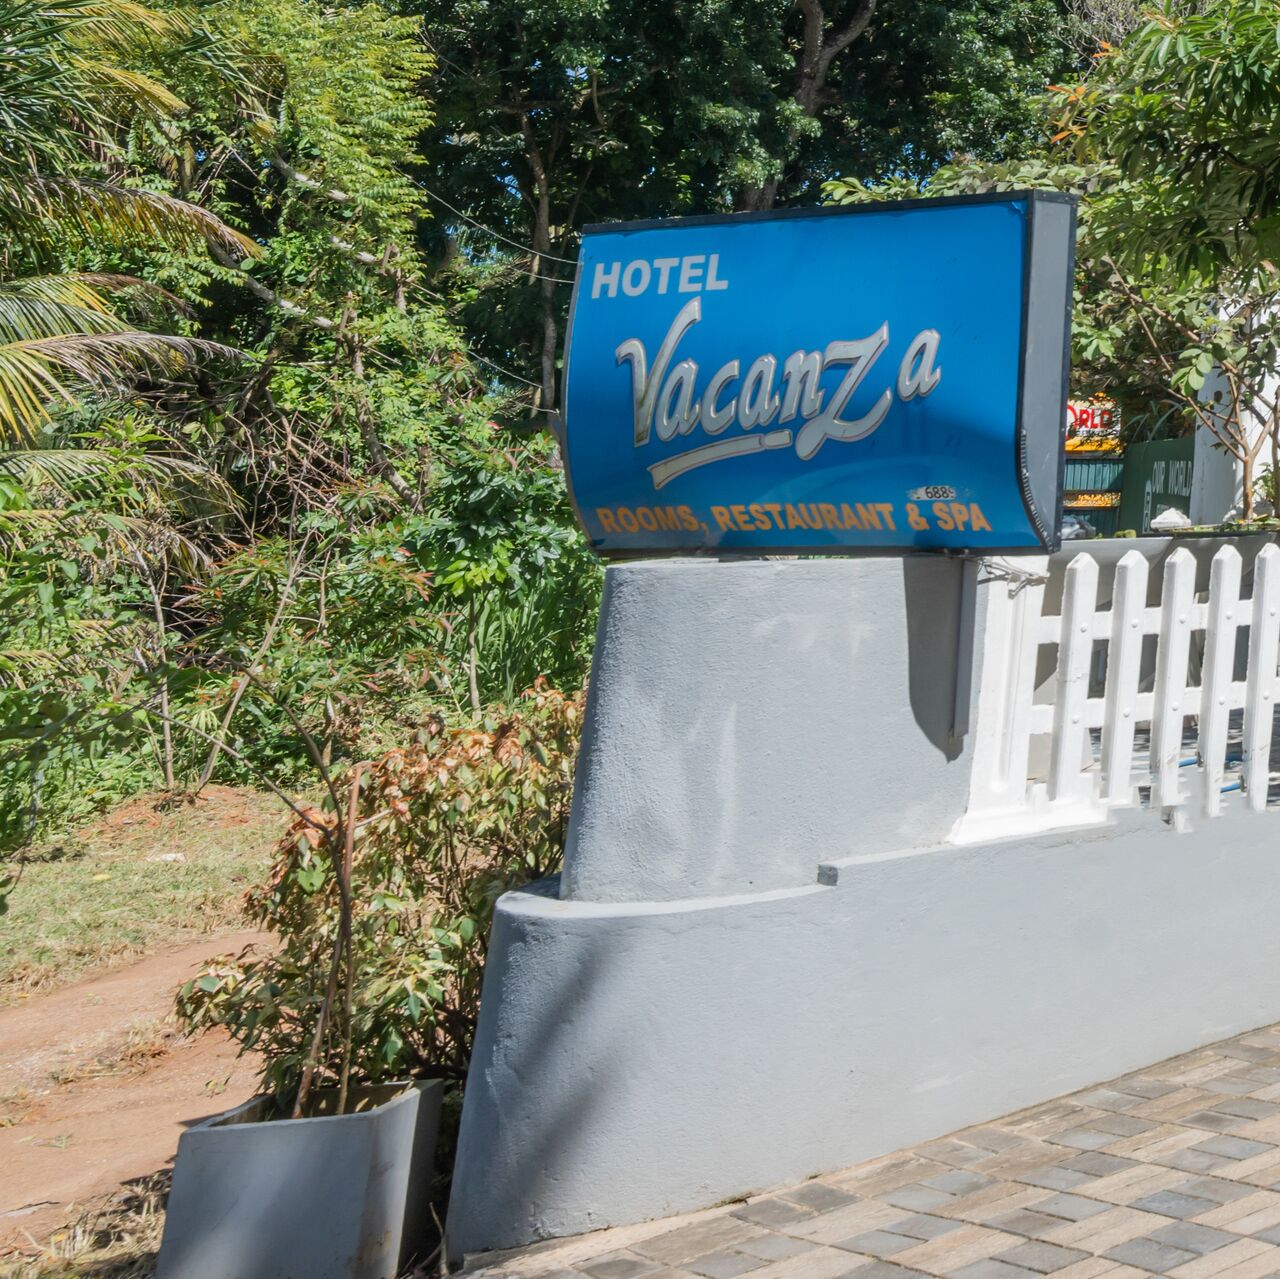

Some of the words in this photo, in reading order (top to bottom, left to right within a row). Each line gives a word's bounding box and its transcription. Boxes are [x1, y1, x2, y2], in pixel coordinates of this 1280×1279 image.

[591, 253, 729, 299] HOTEL
[596, 506, 708, 536] ROOMS,
[711, 502, 896, 532] RESTAURANT
[905, 502, 930, 531] &
[932, 502, 992, 532] SPA
